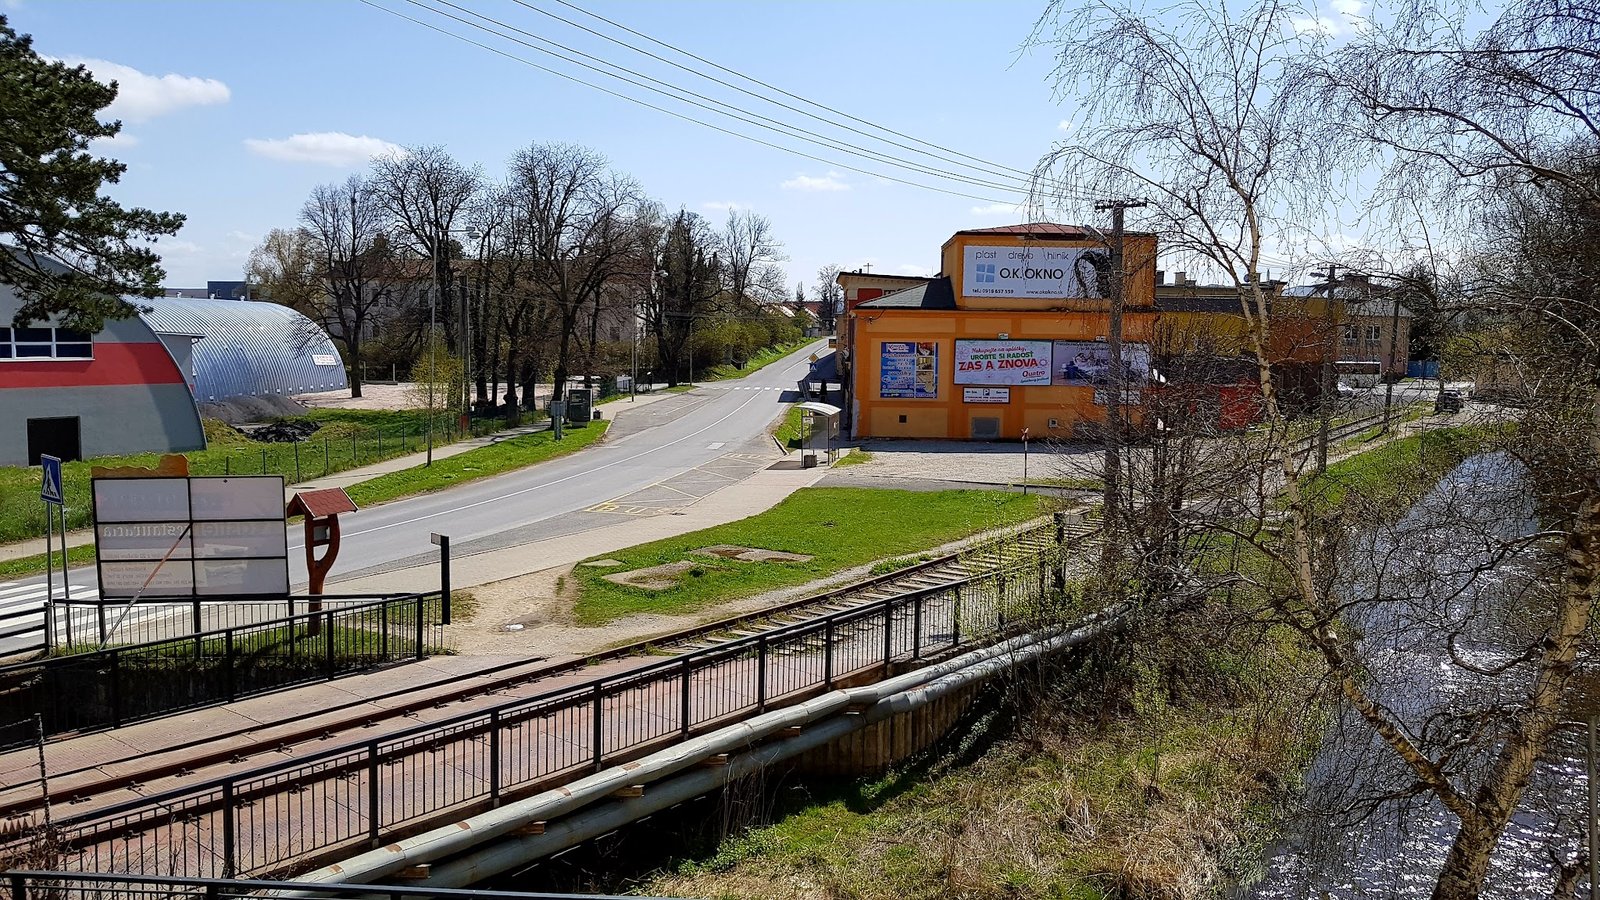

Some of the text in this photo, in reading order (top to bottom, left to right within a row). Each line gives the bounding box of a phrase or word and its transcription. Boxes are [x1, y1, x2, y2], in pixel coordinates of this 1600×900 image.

[976, 250, 997, 260] plast
[1008, 251, 1034, 260] drevo
[1024, 268, 1064, 279] OKNO
[959, 358, 1038, 371] ZAS A ZNOVA
